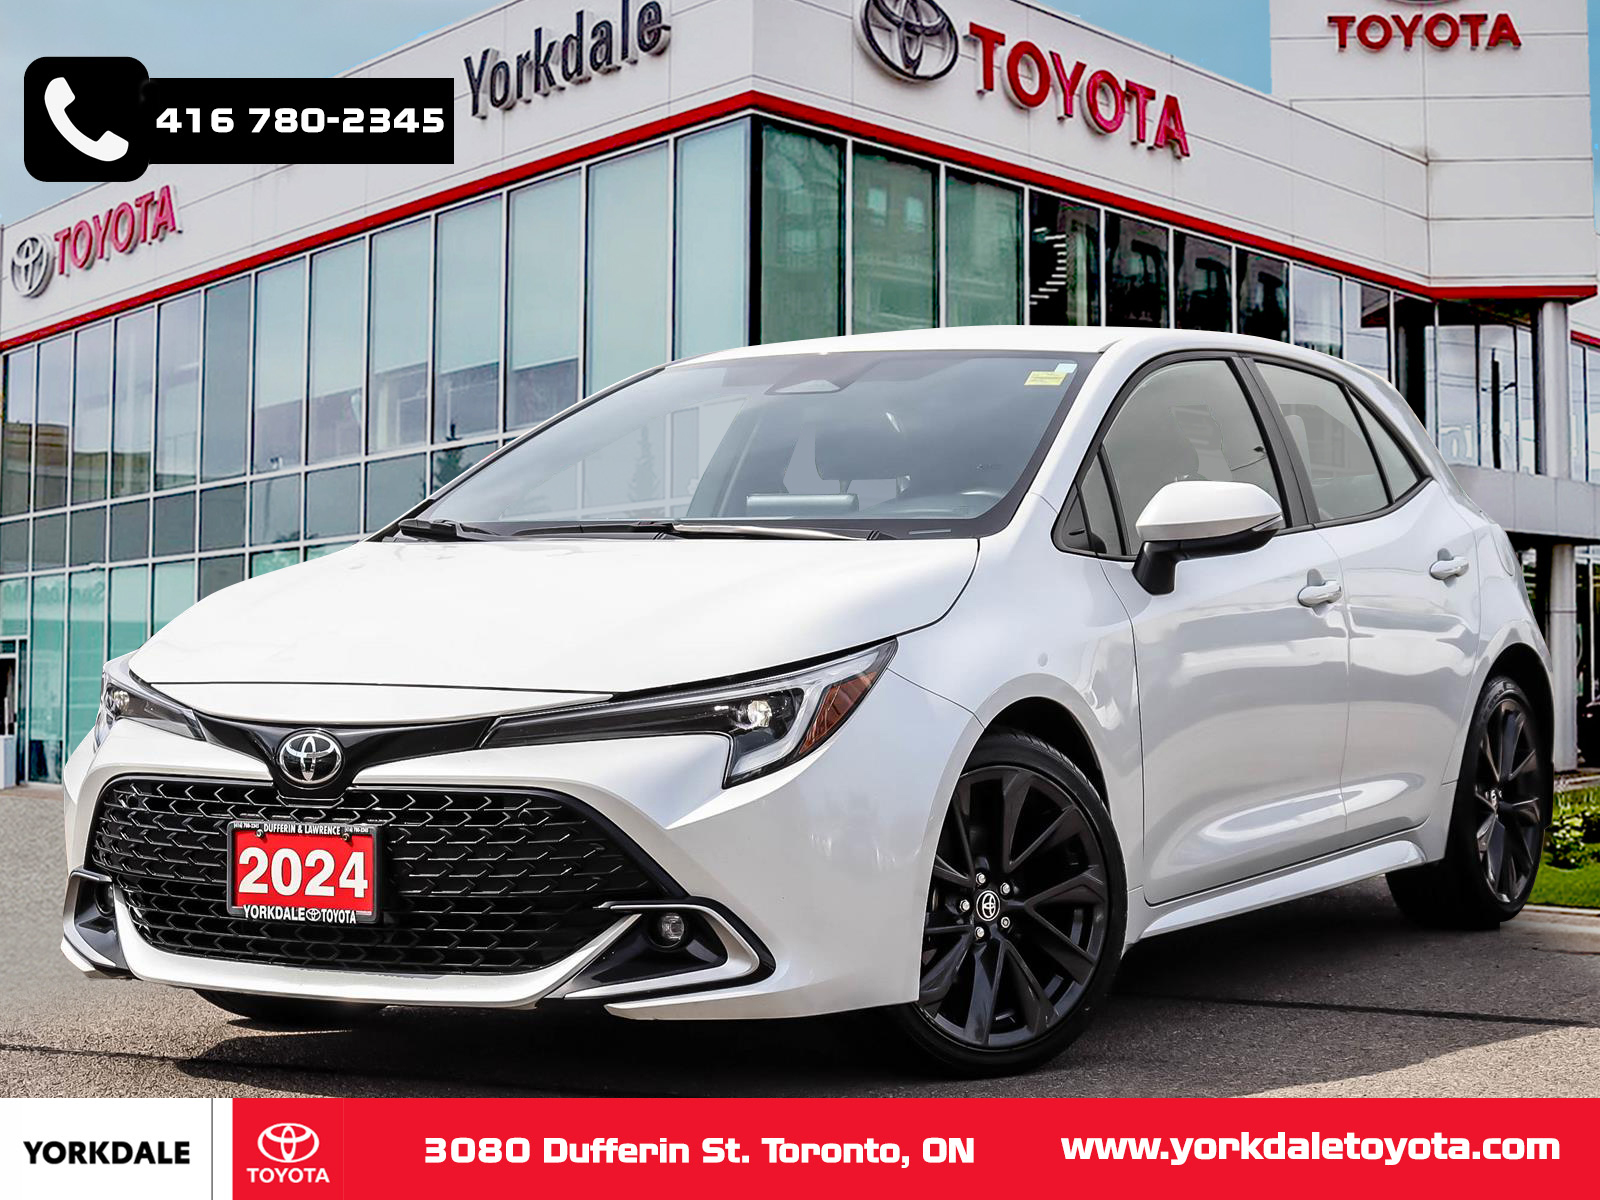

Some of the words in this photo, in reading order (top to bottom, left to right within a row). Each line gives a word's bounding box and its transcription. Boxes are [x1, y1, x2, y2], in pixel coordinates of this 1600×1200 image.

[1327, 13, 1522, 51] TOYOTA
[464, 0, 671, 119] Yorkdale
[969, 22, 1191, 158] TOYOTA
[54, 185, 181, 276] TOYOTA
[263, 822, 296, 834] DUFFERIN
[297, 824, 303, 834] &
[304, 824, 341, 836] LAWRENCE
[238, 846, 368, 898] 2024
[243, 904, 306, 922] YORKDALE
[321, 908, 357, 924] TOYOTA
